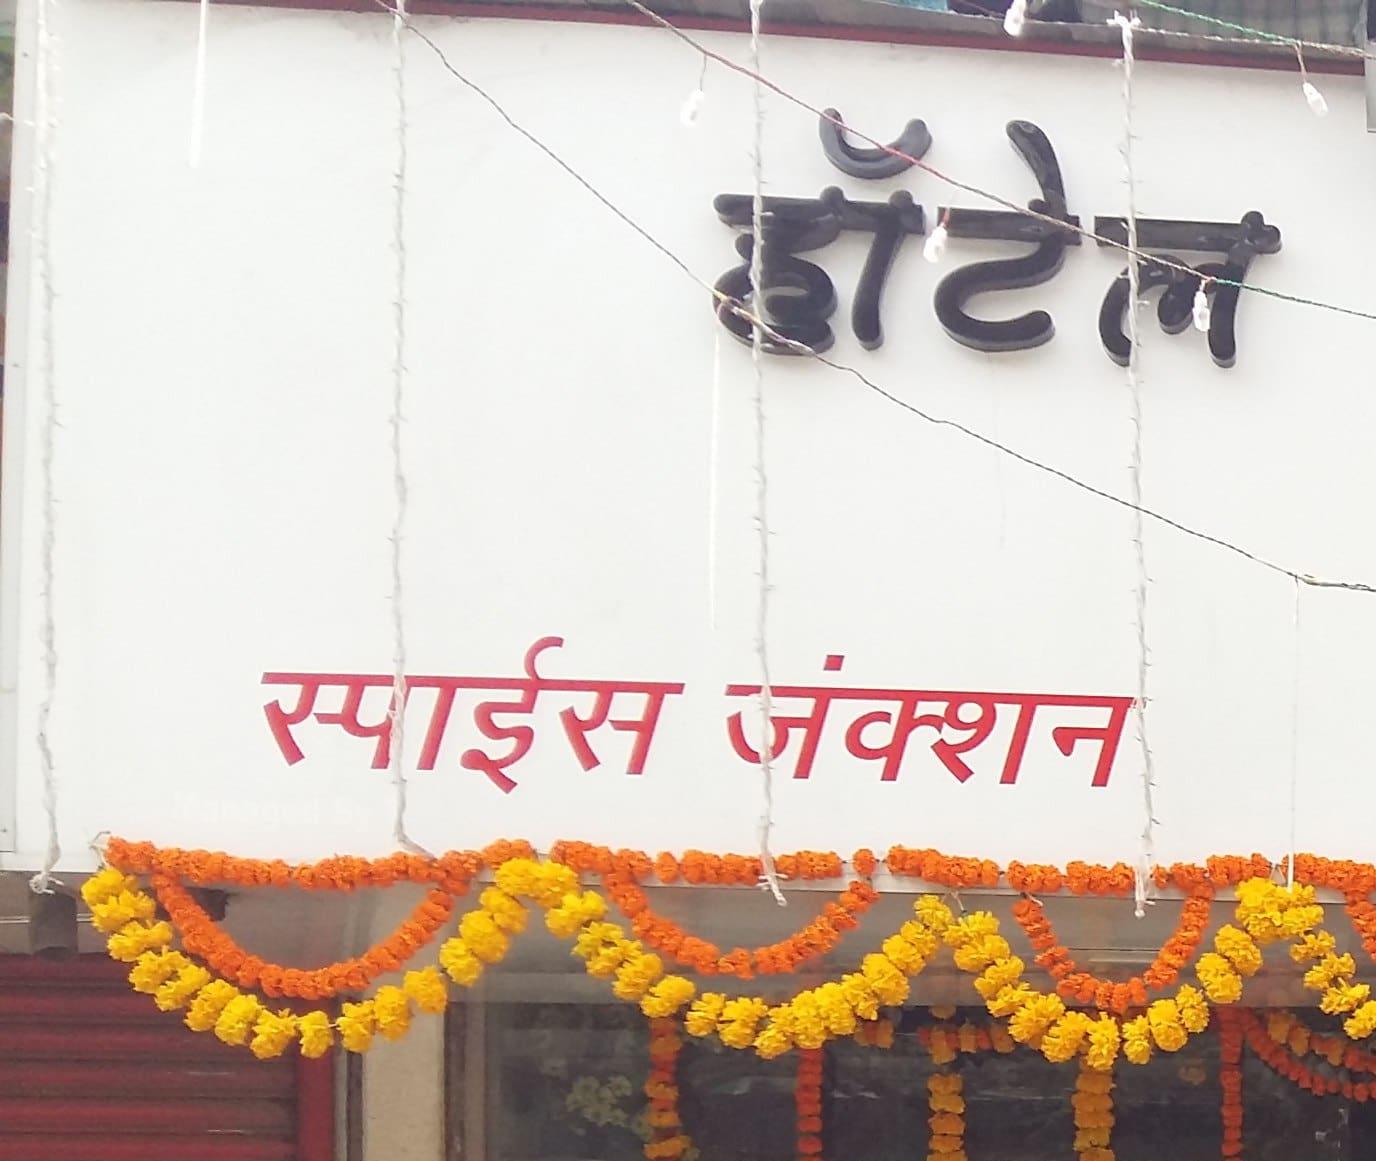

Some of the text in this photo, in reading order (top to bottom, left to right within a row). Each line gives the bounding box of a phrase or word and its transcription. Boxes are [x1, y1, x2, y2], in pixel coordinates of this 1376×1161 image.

[713, 106, 1282, 367] हॉटेल
[260, 637, 1134, 794] स्पाईस जंक्शन
